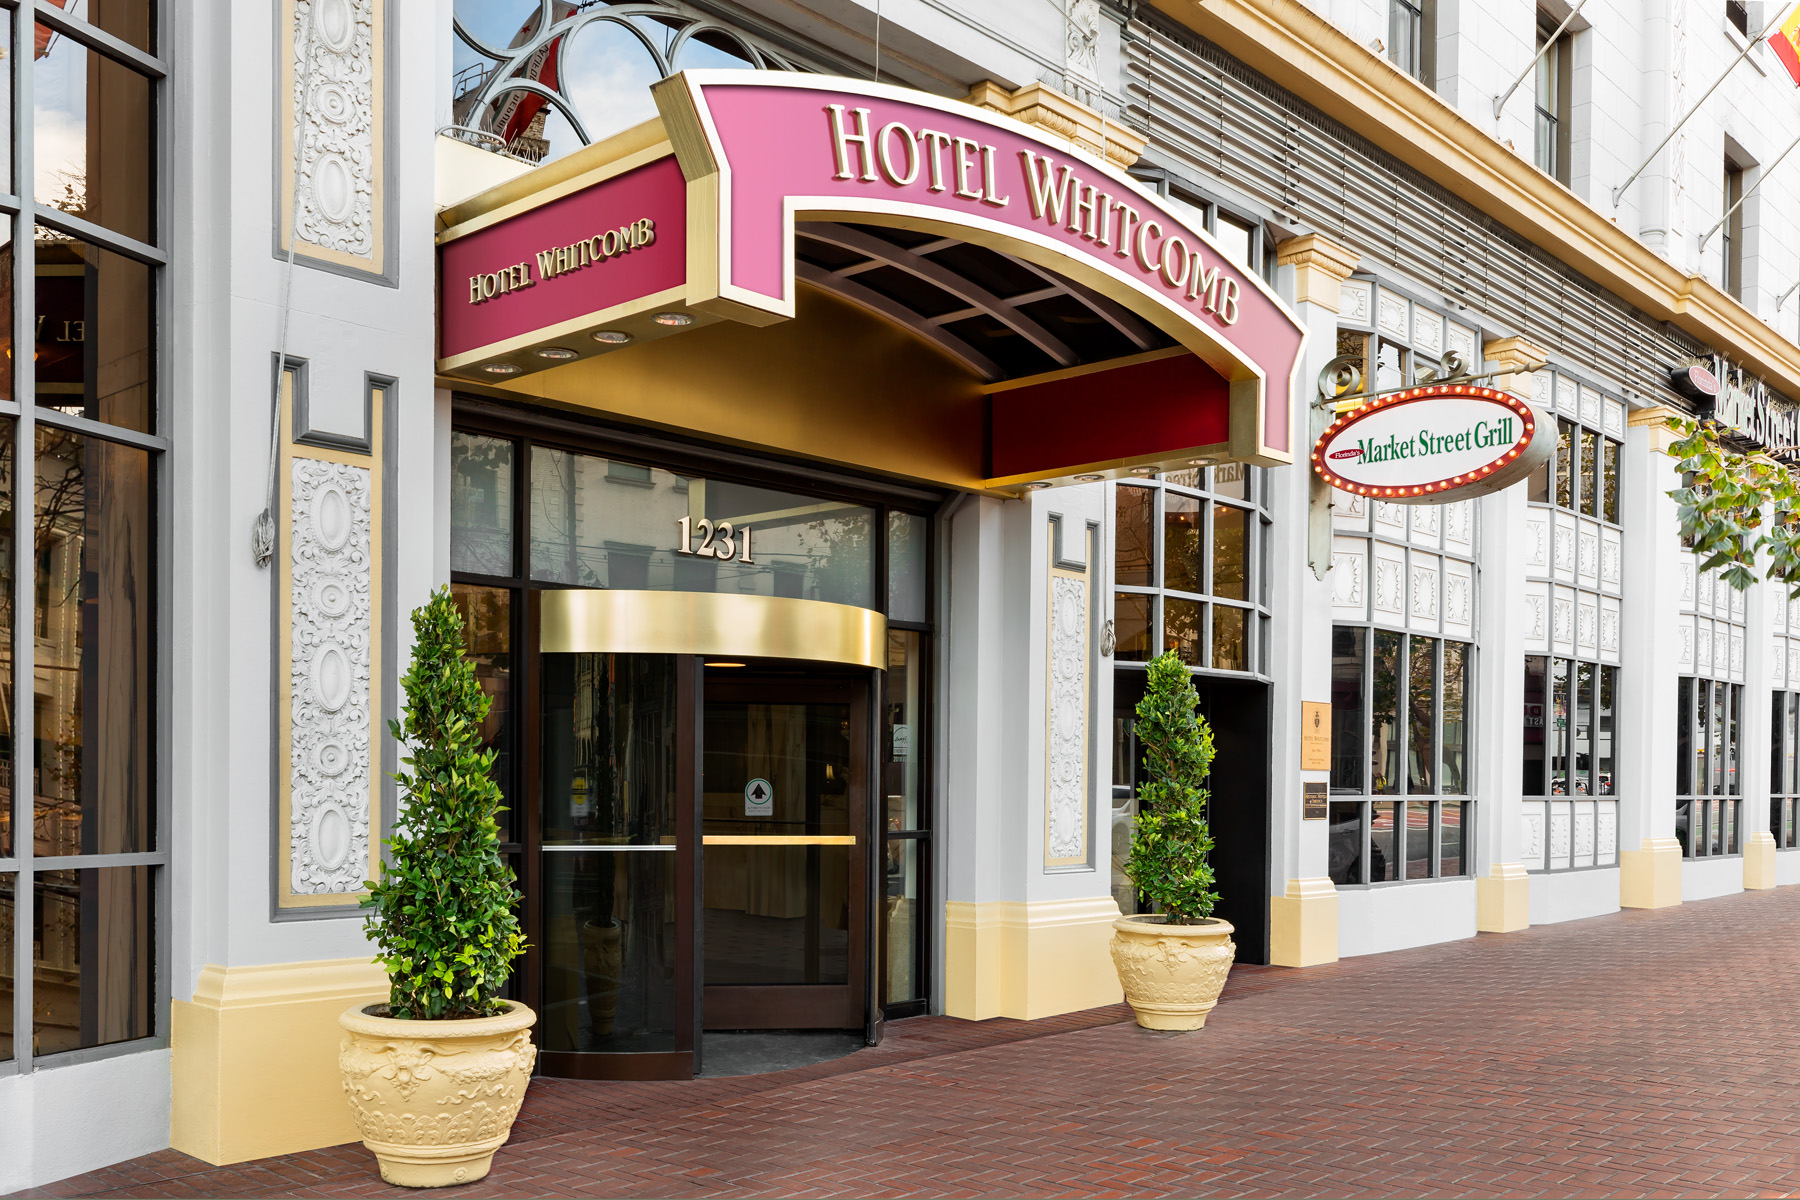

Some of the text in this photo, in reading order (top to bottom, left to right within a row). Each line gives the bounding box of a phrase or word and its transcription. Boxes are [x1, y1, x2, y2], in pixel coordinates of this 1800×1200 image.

[826, 103, 1240, 326] HOTEL WHITCOMB
[469, 217, 656, 304] HOTEL WHITCOMB
[1357, 416, 1514, 465] Market Street Grill
[1713, 353, 1755, 440] Market
[1757, 382, 1796, 461] Street
[1335, 449, 1361, 459] Florinda's
[677, 515, 755, 565] 1231
